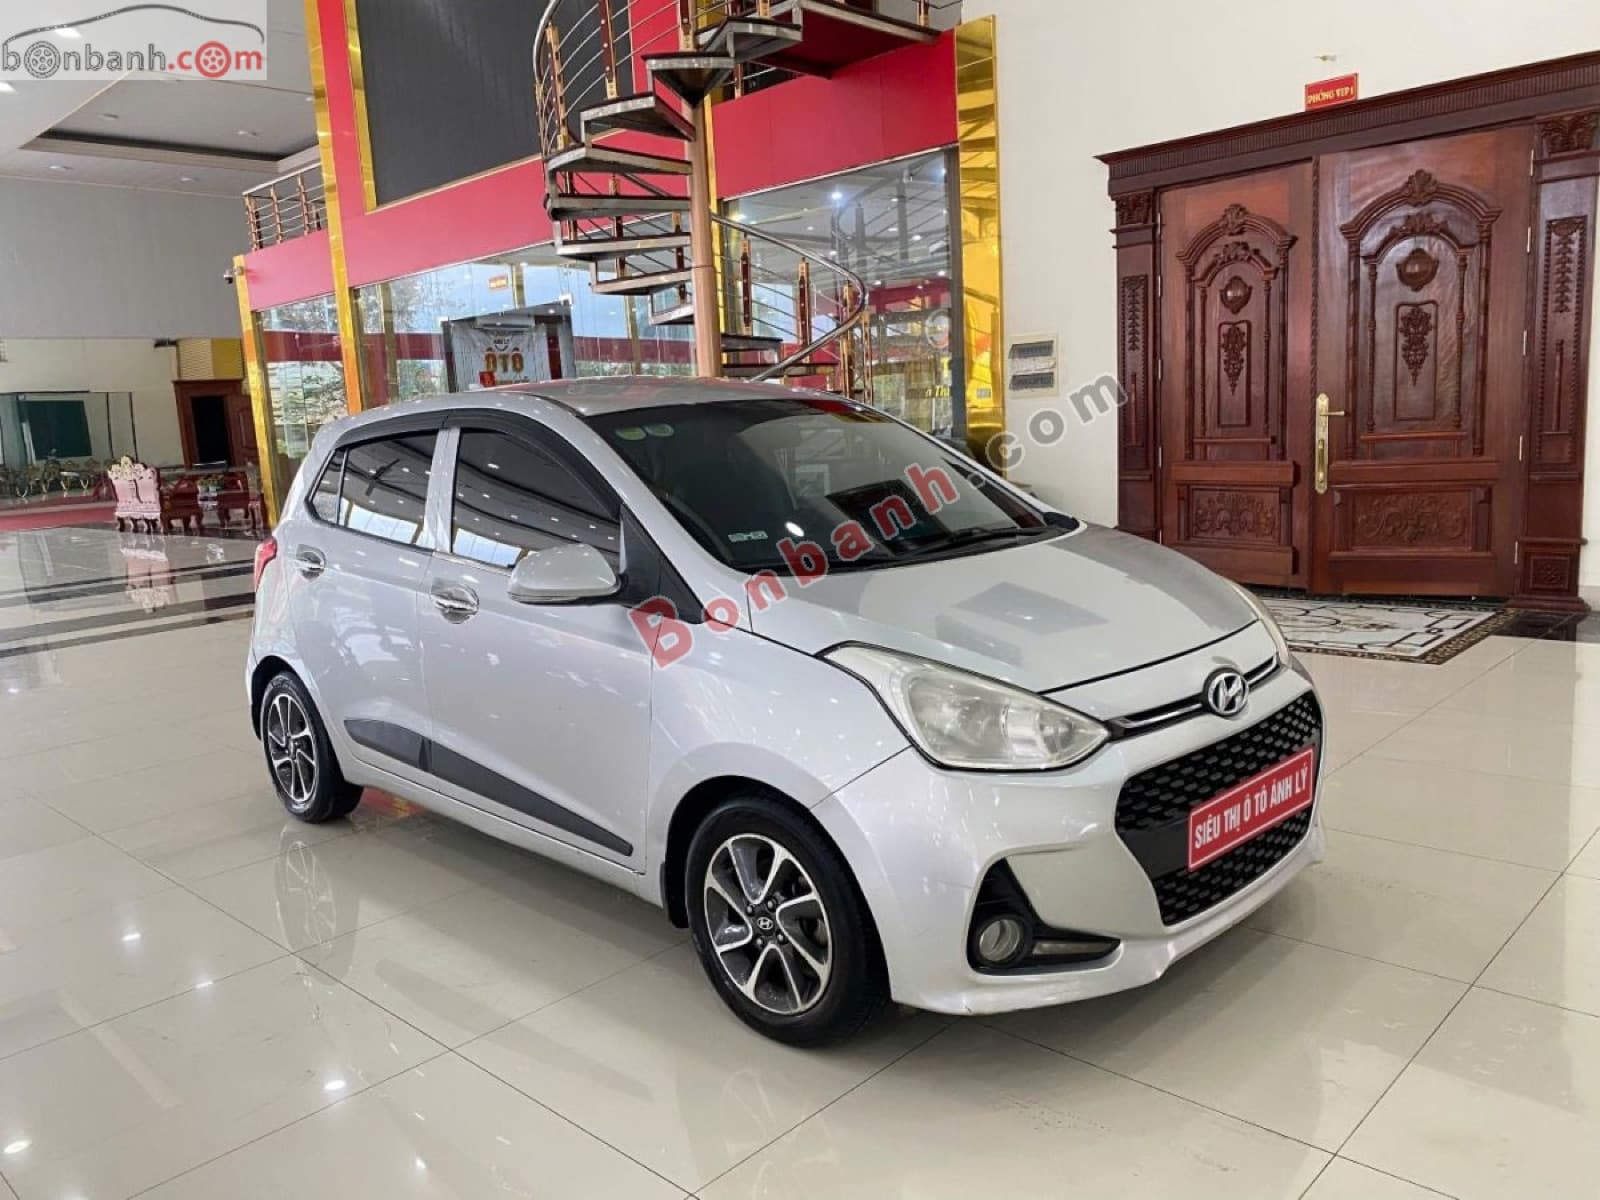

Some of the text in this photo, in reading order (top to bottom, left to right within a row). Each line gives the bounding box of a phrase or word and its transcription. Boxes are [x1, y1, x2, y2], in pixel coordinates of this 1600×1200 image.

[1195, 813, 1221, 849] SIÊU
[1224, 803, 1241, 833] THỊ
[1243, 793, 1252, 822] Ô
[1254, 784, 1268, 816] TÔ
[1295, 762, 1309, 794] LÝ
